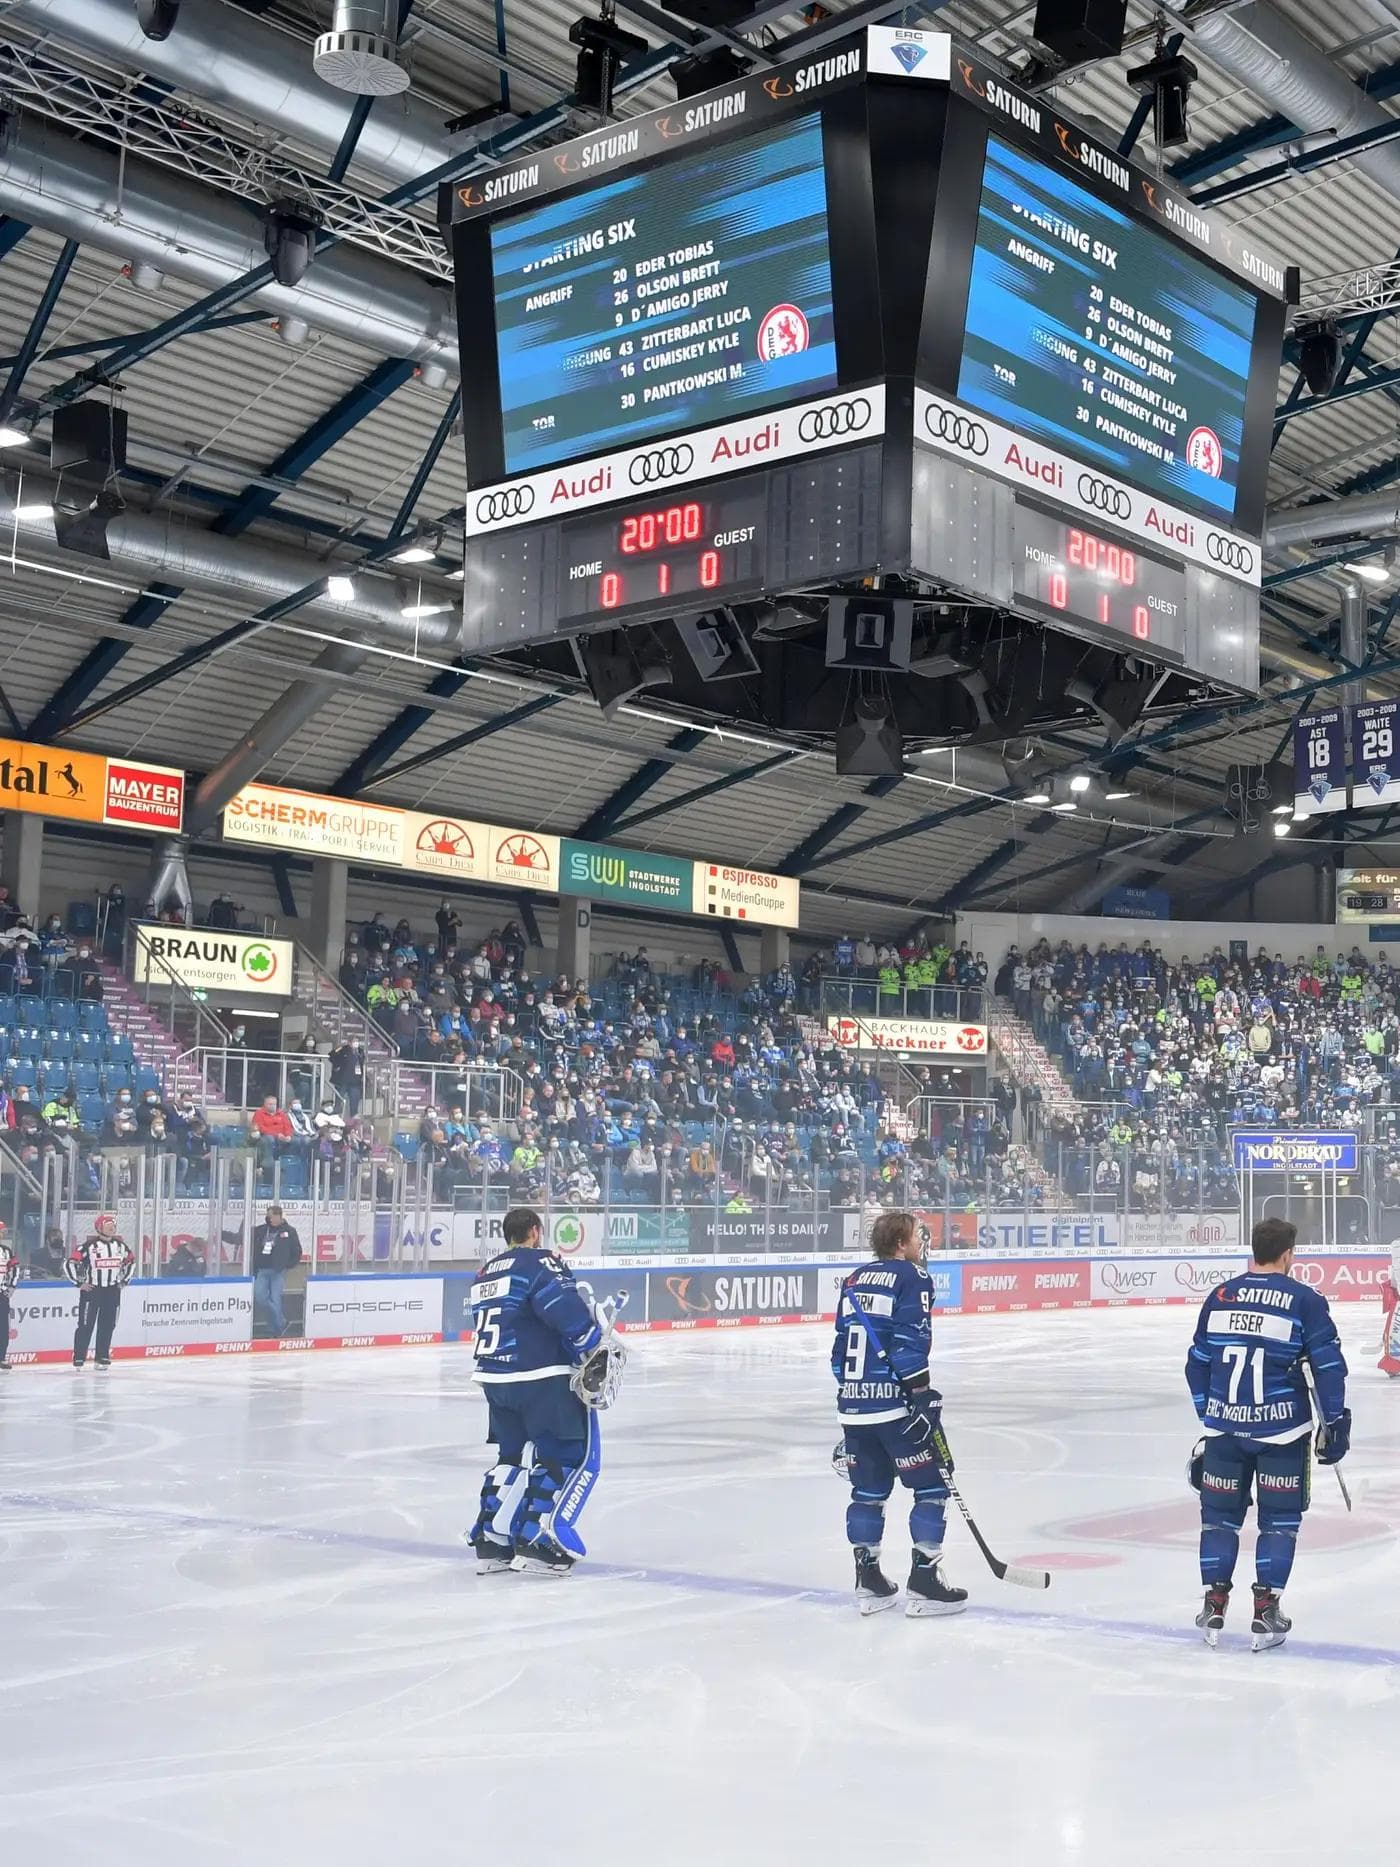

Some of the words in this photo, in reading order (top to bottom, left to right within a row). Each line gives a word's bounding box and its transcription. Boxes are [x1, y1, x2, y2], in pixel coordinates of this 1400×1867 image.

[795, 49, 860, 92] SATURN
[685, 91, 747, 132] SATURN
[986, 80, 1040, 134] SATURN
[582, 130, 638, 169] SATURN
[1080, 141, 1130, 192] SATURN
[485, 165, 539, 203] SATURN
[607, 218, 637, 252] SIX
[1165, 198, 1209, 244] SATURN
[613, 269, 628, 285] 20
[635, 257, 666, 278] EDER
[667, 239, 715, 269] TOBIAS
[1008, 238, 1056, 274] ANGRIFF
[1091, 240, 1119, 270] SIX
[614, 289, 629, 306] 26
[636, 272, 680, 299] OLSON
[682, 259, 721, 285] BRETT
[1242, 251, 1284, 292] SATURN
[525, 285, 574, 312] ANGRIFF
[691, 280, 729, 307] JERRY
[1089, 285, 1104, 302] 20
[1109, 296, 1135, 320] EDER
[1135, 311, 1172, 341] TOBIAS
[618, 341, 634, 357] 43
[641, 316, 716, 351] ZITTERBART
[717, 305, 752, 329] LUCA
[1087, 305, 1101, 323] 26
[1107, 317, 1142, 347] OLSON
[1144, 336, 1174, 363] BRETT
[620, 363, 635, 379] 16
[642, 342, 707, 373] CUMISKEY
[708, 332, 740, 353] KYLE
[620, 394, 636, 410] 30
[643, 367, 727, 404] PANTKOWSKI
[1082, 356, 1097, 374] 43
[1102, 364, 1160, 409] ZITTERBART
[1162, 399, 1188, 422] LUCA
[1147, 360, 1177, 386] JERRY
[1081, 377, 1094, 395] 16
[1100, 387, 1151, 424] CUMISKEY
[1152, 416, 1177, 437] KYLE
[711, 423, 780, 464] Audi
[1076, 405, 1090, 424] 30
[1096, 415, 1163, 458] PANTKOWSKI
[1004, 443, 1064, 489] Audi
[550, 466, 614, 504] Audi
[714, 526, 756, 548] GUEST
[1144, 507, 1195, 547] Audi
[570, 561, 603, 580] HOME
[1025, 545, 1057, 568] HOME
[601, 573, 620, 608] 0
[701, 551, 720, 588] 0
[1050, 573, 1067, 609] 0
[1147, 595, 1178, 617] GUEST
[1310, 727, 1327, 740] AST
[1364, 717, 1391, 731] WAITE
[1307, 738, 1331, 769] 18
[1362, 728, 1393, 761] 29
[108, 776, 180, 804] MAYER
[108, 797, 179, 818] BAUZENTRUM
[571, 852, 625, 888] SWI
[628, 869, 681, 887] STADTWERKE
[722, 868, 779, 890] espresso
[628, 881, 681, 897] INGOLSTADT
[720, 886, 785, 910] MedienGruppe
[577, 909, 590, 928] D
[149, 935, 238, 964] BRAUN
[183, 967, 237, 983] entsorgen
[871, 1021, 948, 1036] BACKHAUS
[871, 1033, 948, 1050] Hackner
[1246, 1143, 1343, 1162] NORDBRÄU
[706, 1223, 747, 1236] HELLO!
[978, 1225, 1119, 1249] STIEFEL
[714, 1275, 804, 1311] SATURN
[856, 1271, 898, 1289] SATURN
[142, 1299, 185, 1314] Immer
[186, 1298, 198, 1312] in
[200, 1298, 226, 1312] den
[312, 1298, 424, 1315] PORSCHE
[1236, 1287, 1294, 1310] SATURN
[1229, 1312, 1264, 1333] FESER
[844, 1324, 868, 1381] 9
[1222, 1345, 1265, 1405] 71
[560, 1470, 593, 1521] VAUGHN
[1202, 1472, 1239, 1491] CINQUE
[1259, 1472, 1300, 1490] CINQUE
